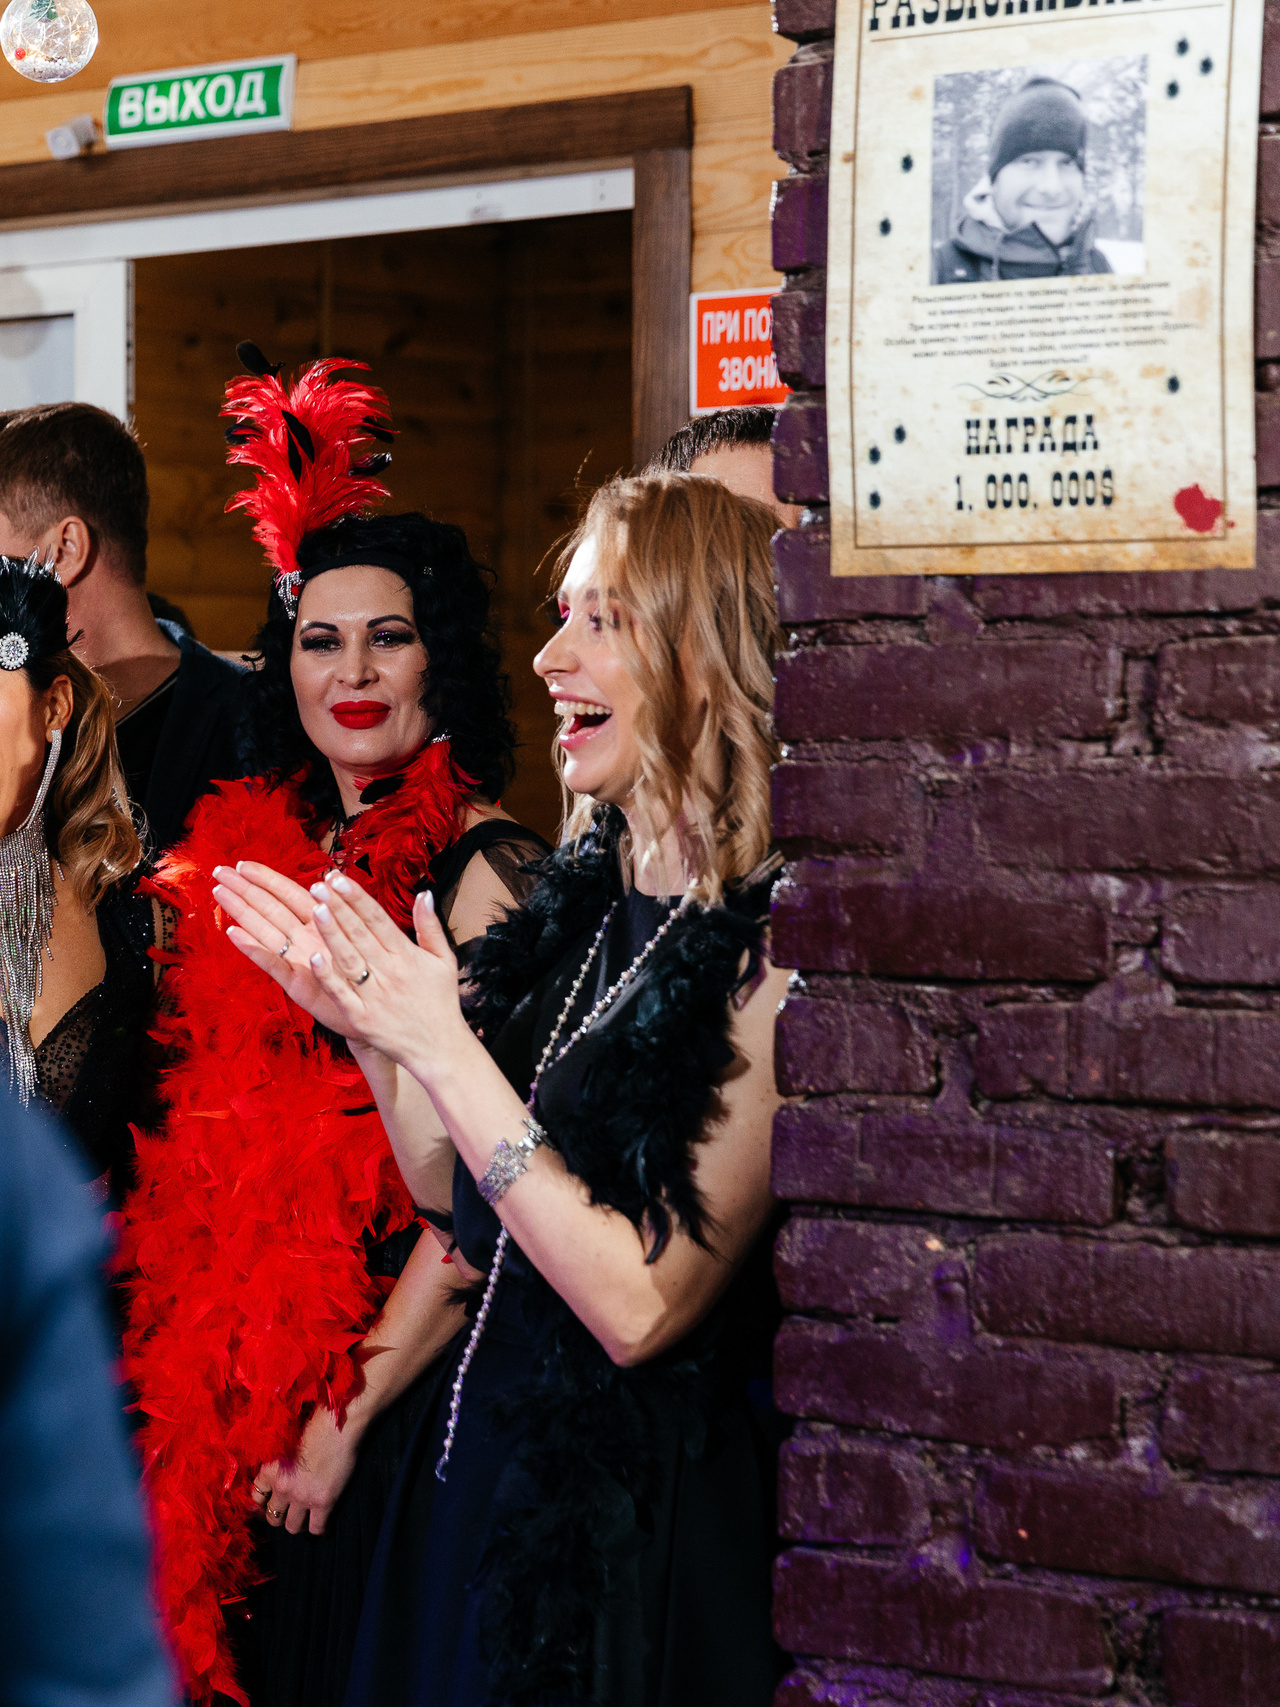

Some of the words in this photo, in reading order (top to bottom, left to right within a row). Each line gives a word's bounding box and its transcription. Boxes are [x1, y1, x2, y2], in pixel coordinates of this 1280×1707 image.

[118, 70, 267, 129] ВЫХОД
[702, 309, 740, 345] ПРИ
[744, 306, 773, 342] ПО
[718, 352, 787, 392] ЗВОНИ
[966, 414, 1099, 456] НАГРАДА
